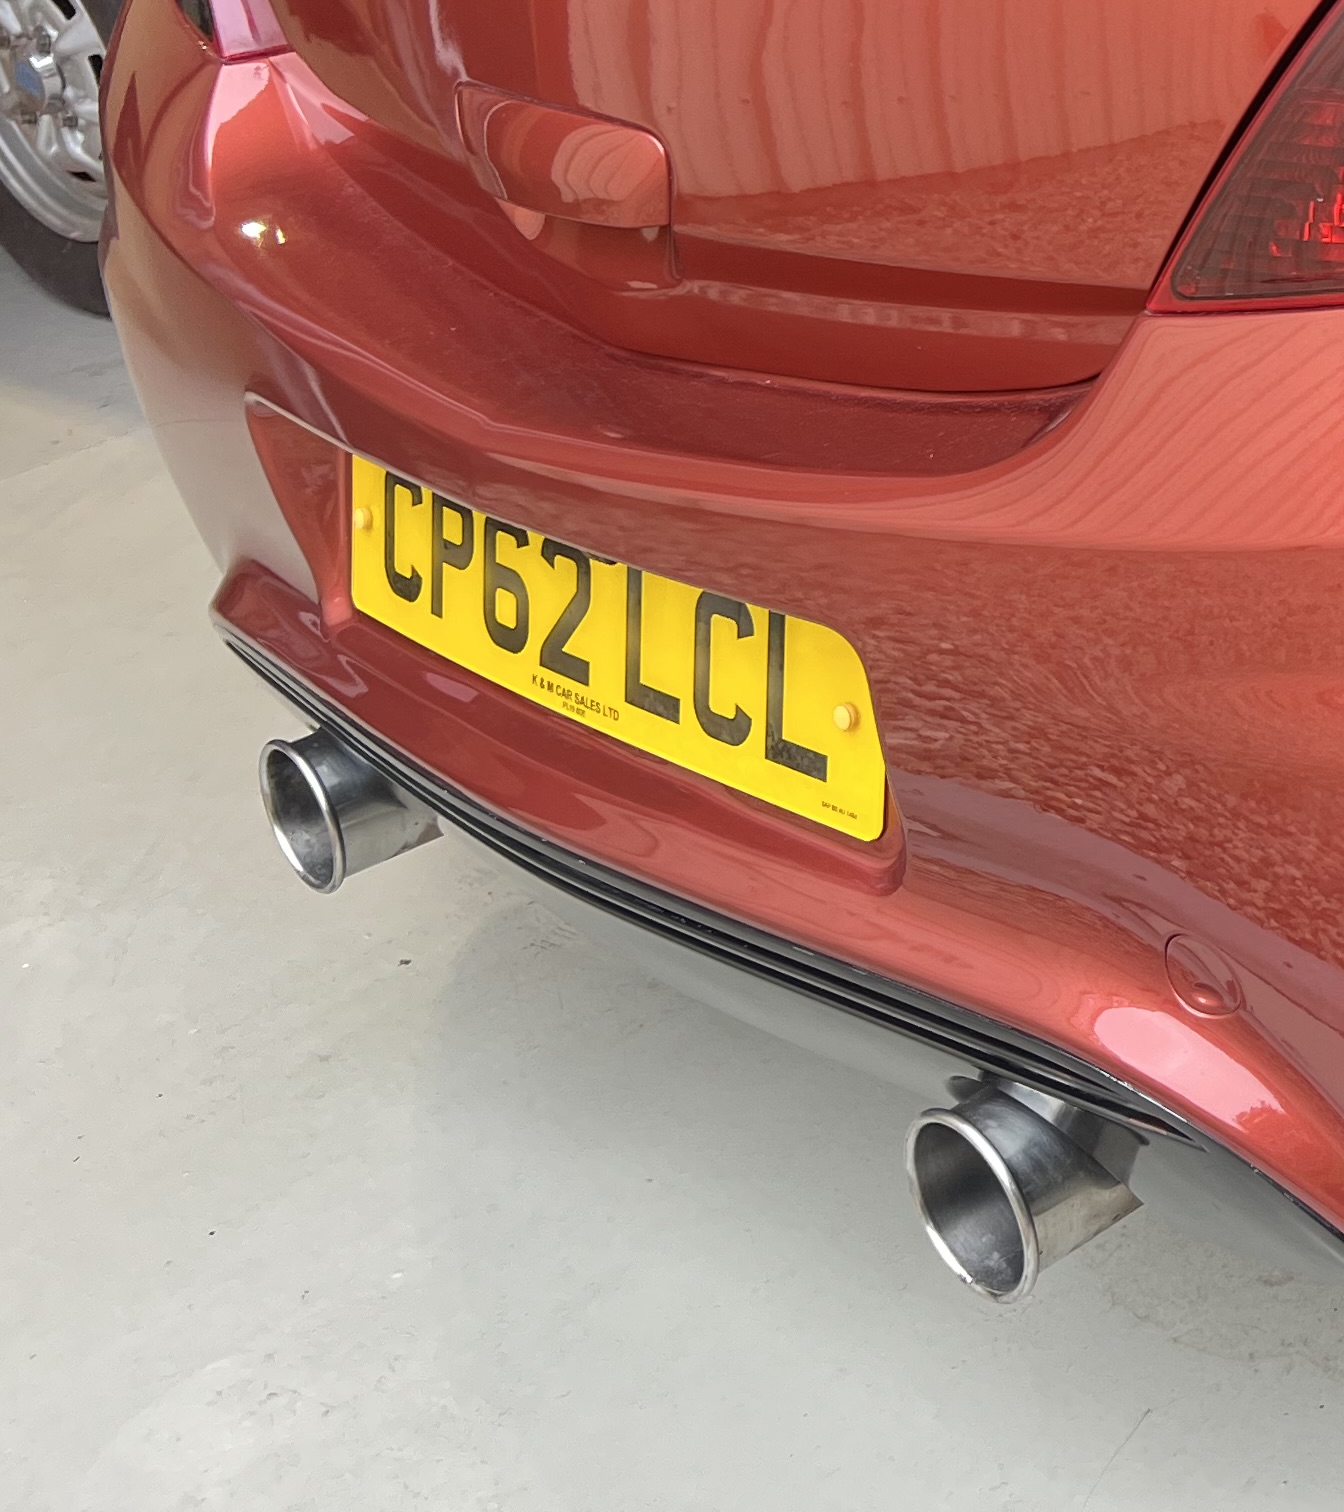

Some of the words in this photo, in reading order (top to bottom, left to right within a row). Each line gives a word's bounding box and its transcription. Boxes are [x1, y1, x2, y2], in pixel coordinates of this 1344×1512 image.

[383, 470, 591, 687] CP62
[625, 569, 829, 783] LCL
[555, 684, 573, 702] CAR
[574, 692, 601, 714] SALES
[603, 705, 620, 721] LTD
